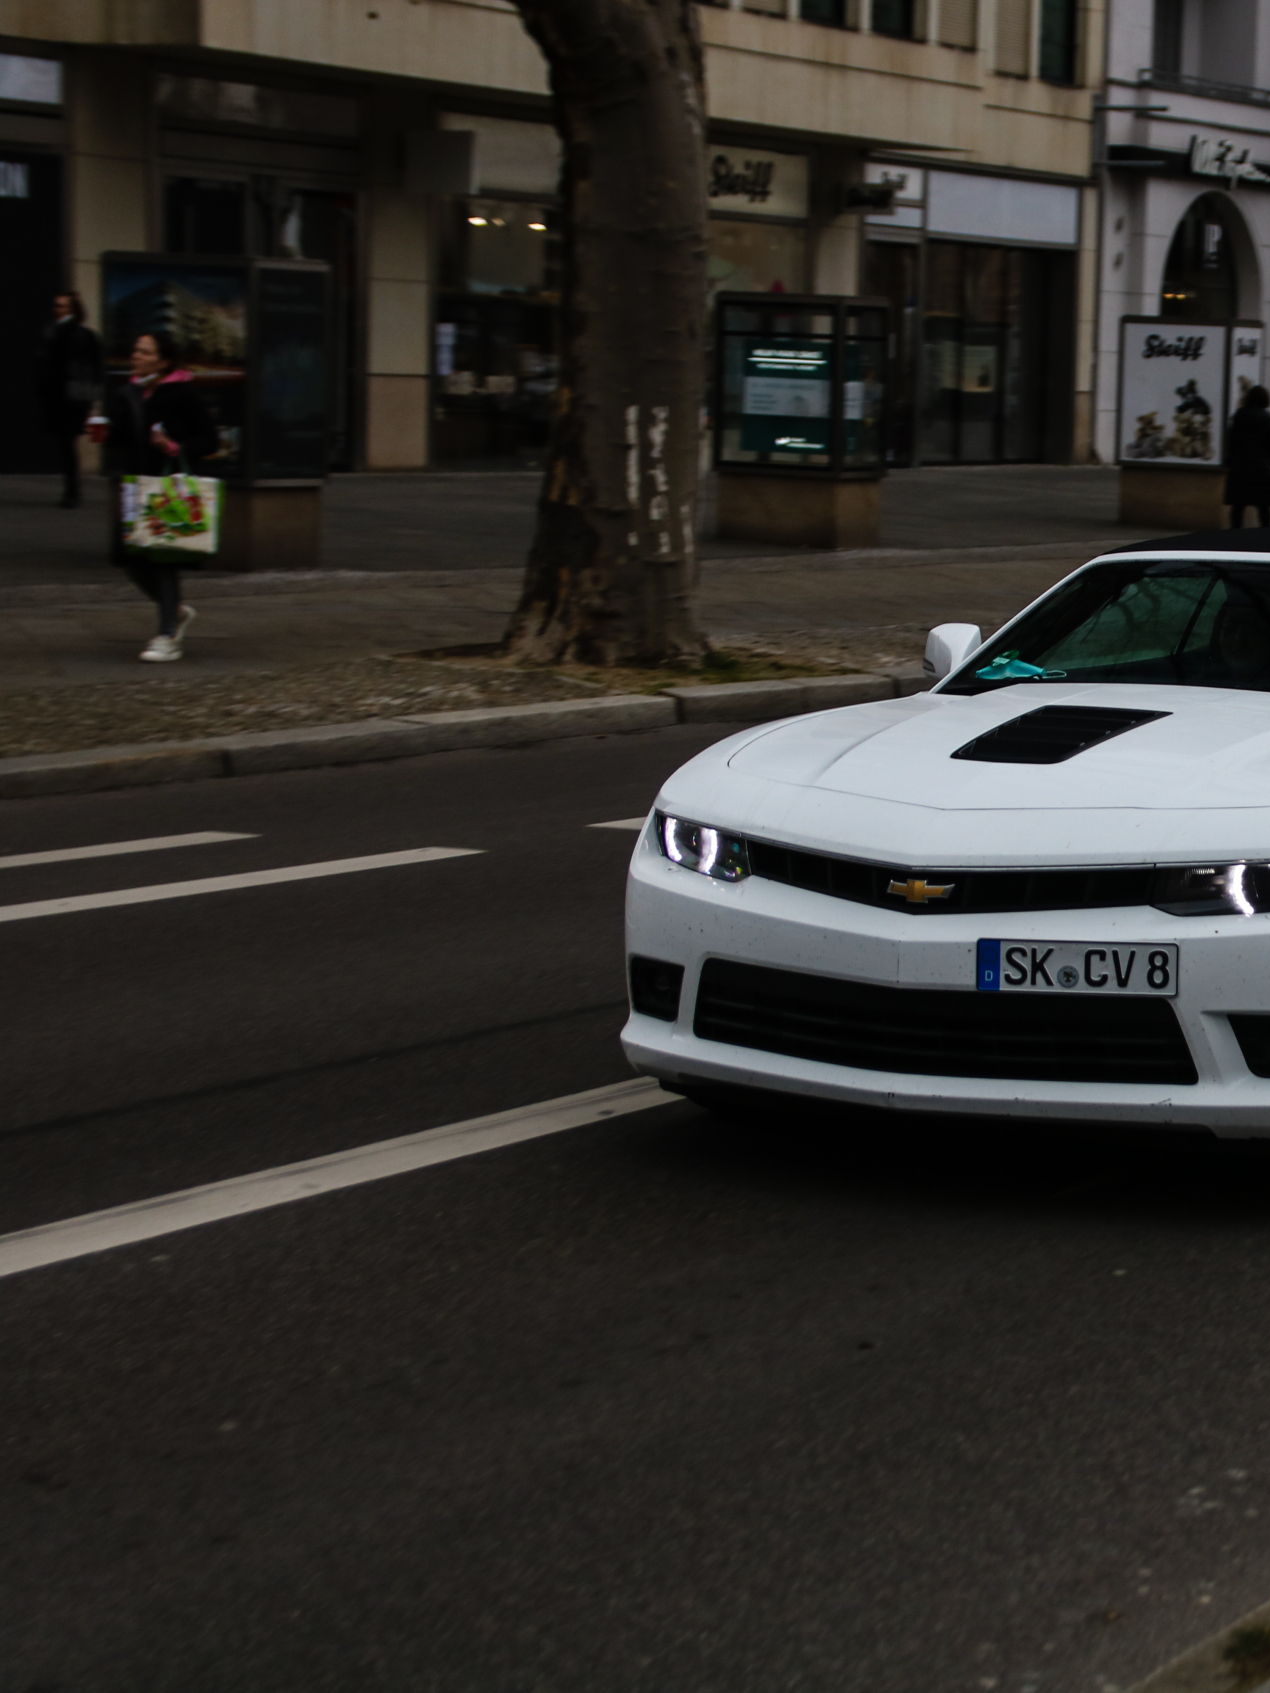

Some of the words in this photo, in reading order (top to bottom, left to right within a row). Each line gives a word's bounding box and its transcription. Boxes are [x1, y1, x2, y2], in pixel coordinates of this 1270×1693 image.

[708, 154, 774, 203] Steiff
[1142, 334, 1206, 361] Steiff
[984, 970, 994, 982] D
[1004, 946, 1055, 986] SK
[1084, 949, 1136, 988] CV
[1147, 950, 1170, 989] 8
